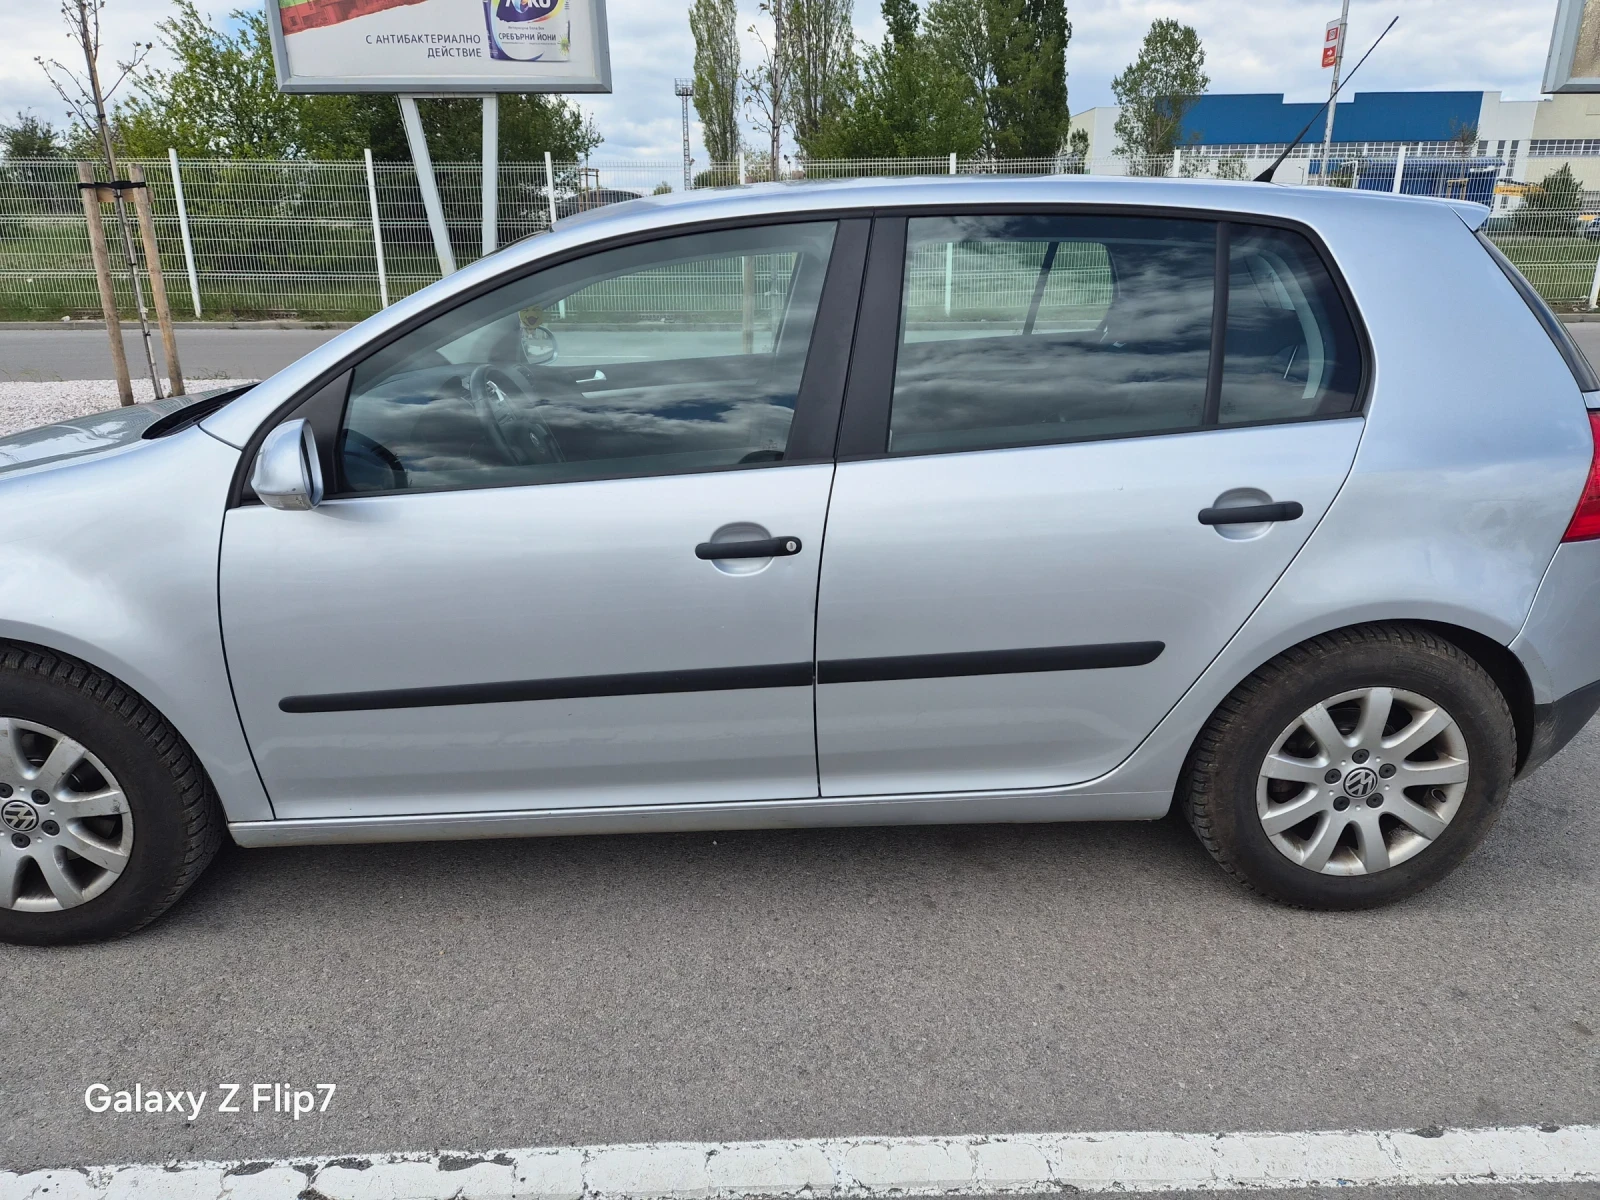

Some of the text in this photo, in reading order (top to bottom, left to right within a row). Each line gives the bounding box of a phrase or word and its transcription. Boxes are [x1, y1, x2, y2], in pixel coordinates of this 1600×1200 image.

[365, 34, 481, 44] С АНТИБАКТЕРИАЛНО
[498, 32, 557, 41] СРЕБЪРНИ ЙОНИ
[427, 46, 482, 58] ДЕЙСТВИЕ
